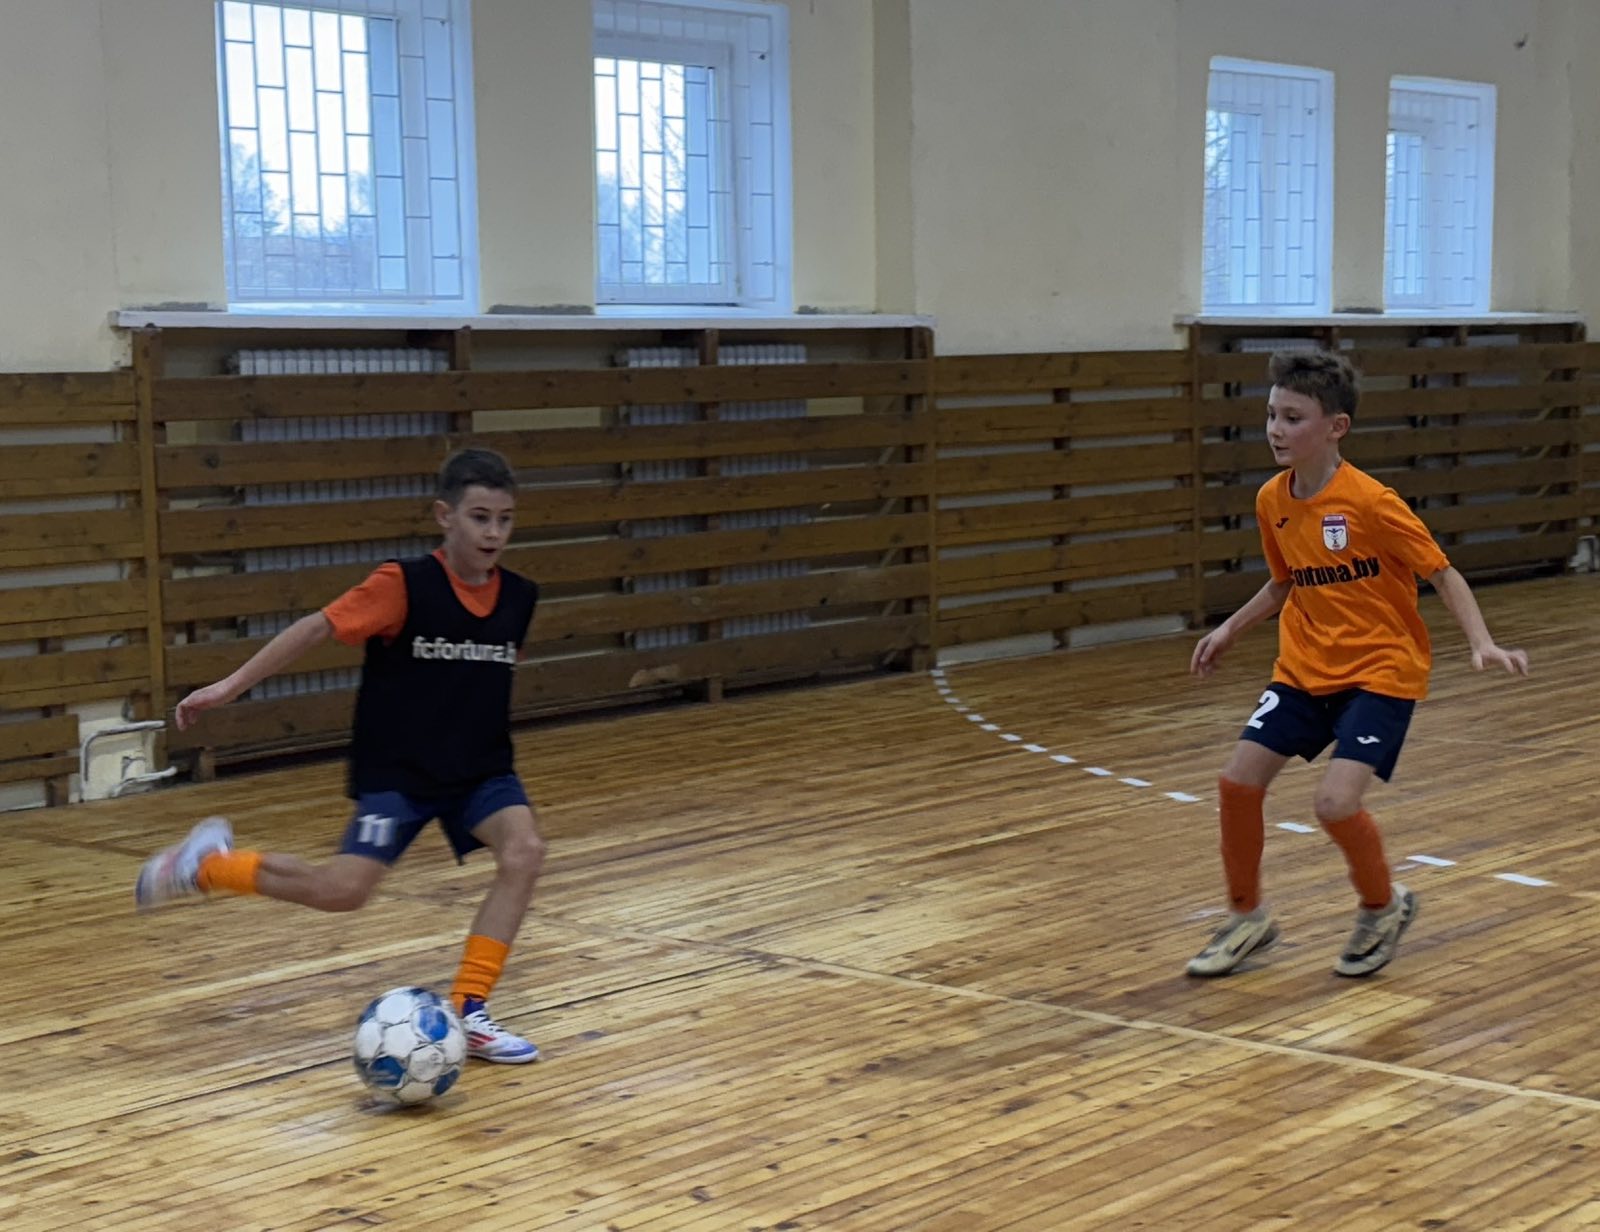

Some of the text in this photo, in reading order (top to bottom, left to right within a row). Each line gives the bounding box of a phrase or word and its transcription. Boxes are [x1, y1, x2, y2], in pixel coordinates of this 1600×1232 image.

[411, 635, 518, 664] fcfortuna.b
[1247, 691, 1280, 729] 2
[357, 813, 393, 848] 11
